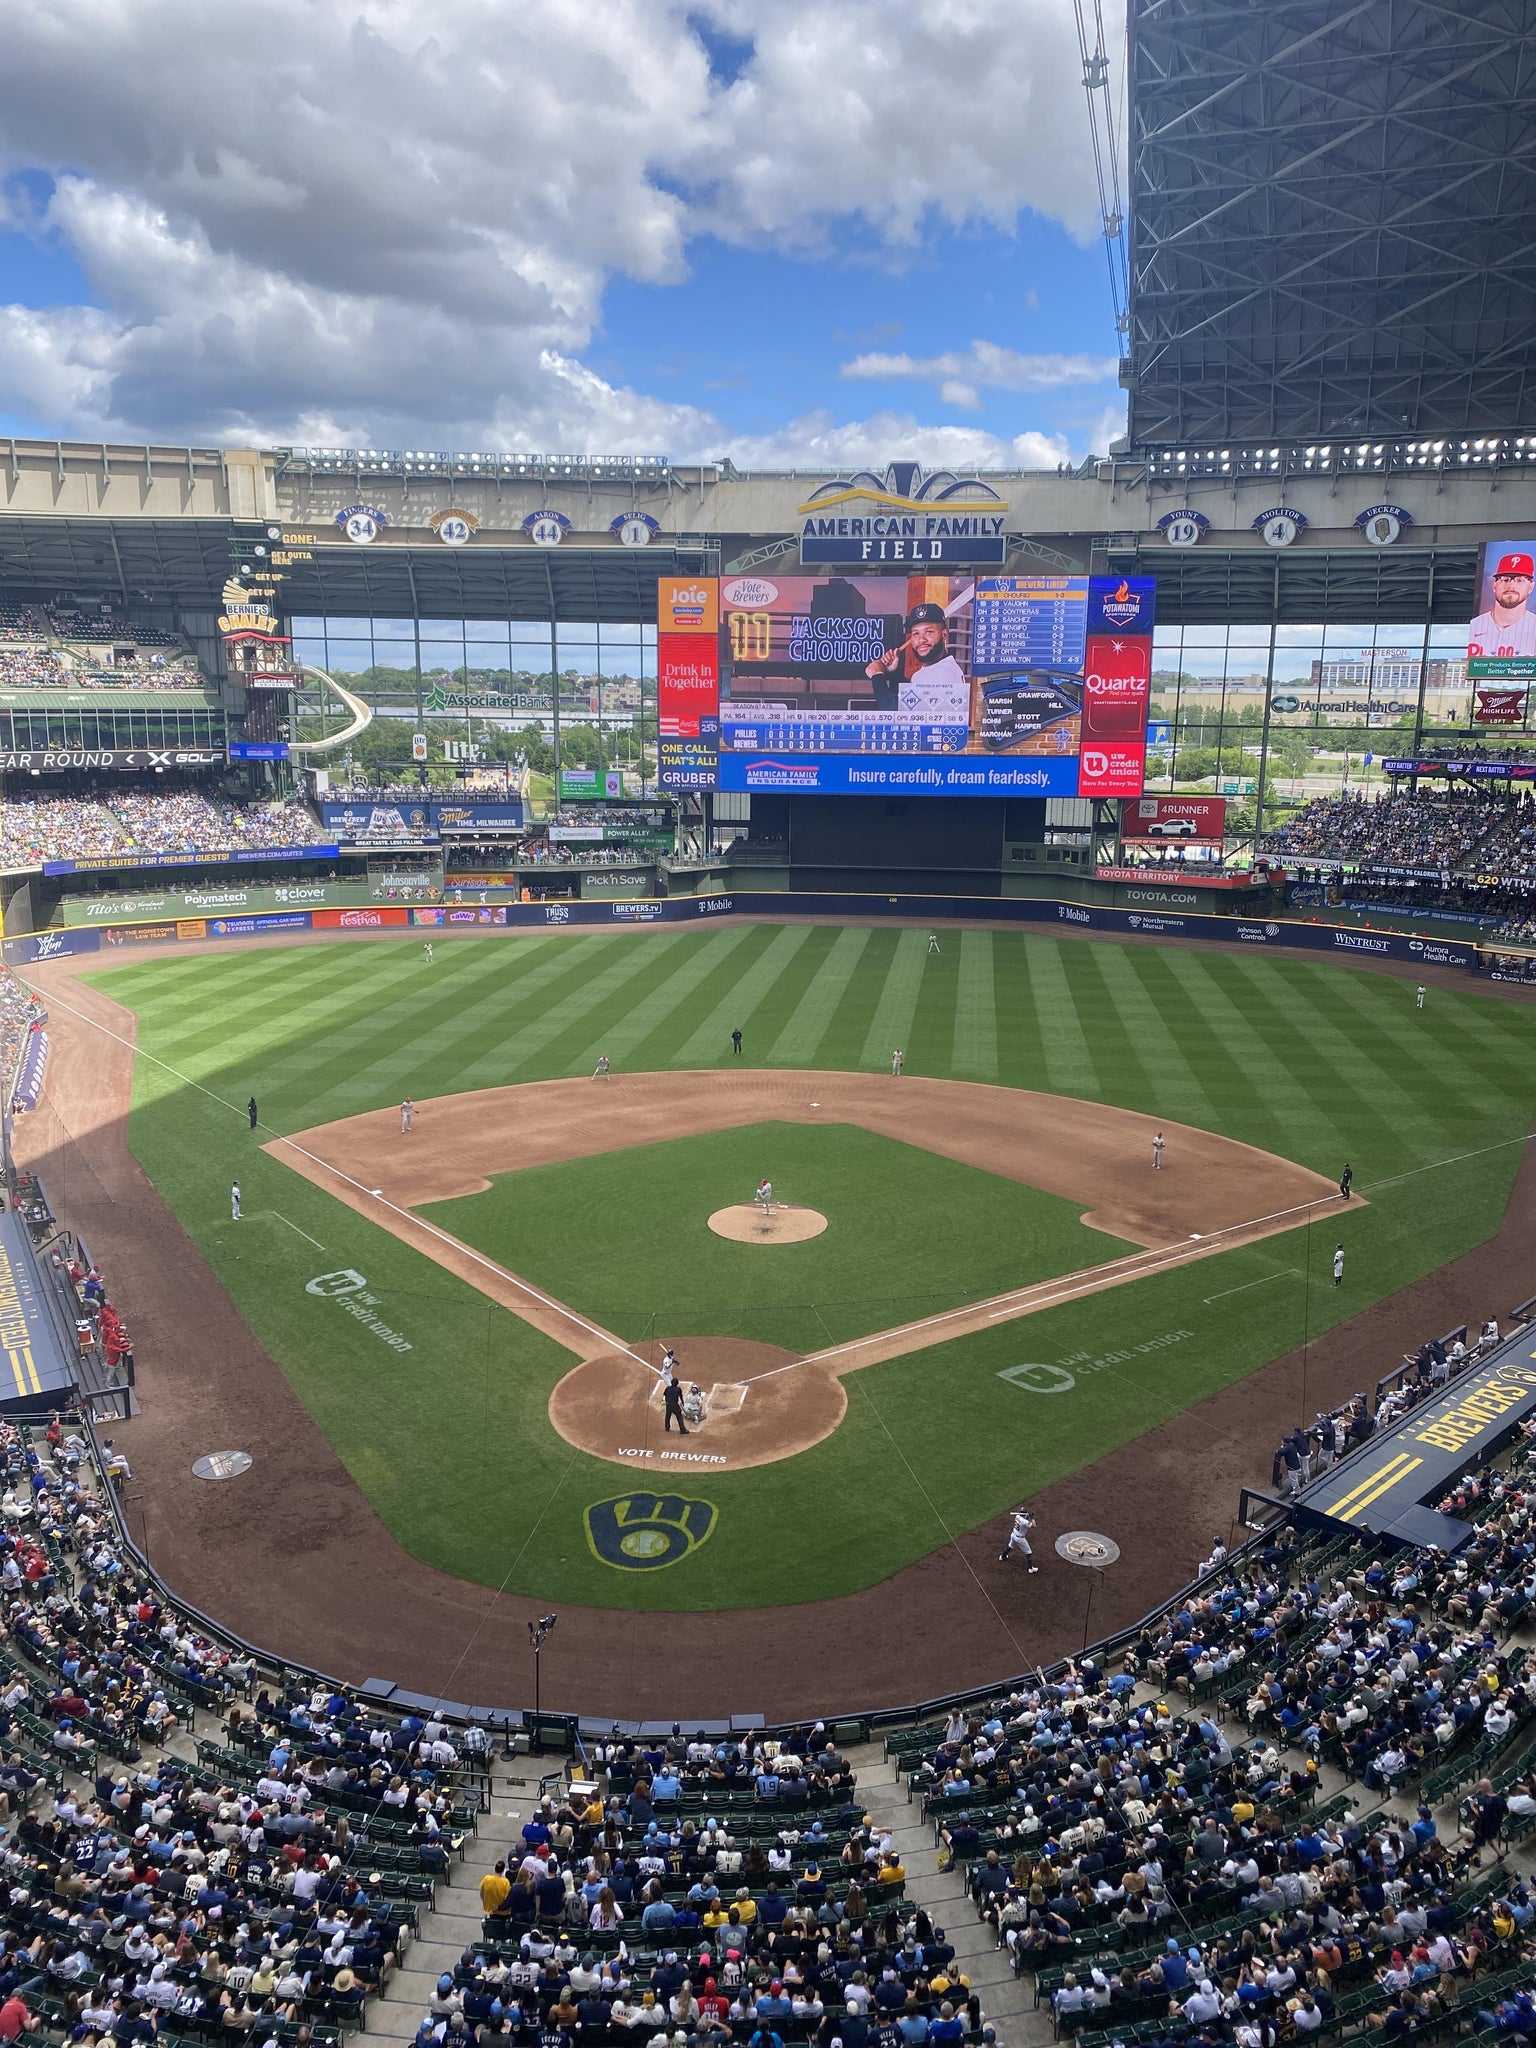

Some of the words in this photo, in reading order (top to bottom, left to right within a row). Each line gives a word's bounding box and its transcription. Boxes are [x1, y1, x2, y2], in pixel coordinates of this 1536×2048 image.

[343, 506, 378, 518] FINGERS
[534, 512, 560, 520] AARON
[624, 512, 646, 522] SELIG
[1170, 510, 1198, 520] YOUNT
[1261, 510, 1300, 522] MOLITOR
[1366, 506, 1400, 517] UECKER
[350, 520, 374, 536] 34
[444, 522, 466, 538] 42
[536, 523, 558, 538] 44
[803, 518, 916, 536] AMERICAN
[926, 517, 1005, 535] FAMILY
[1171, 524, 1194, 542] 19
[1271, 522, 1284, 540] 4
[282, 534, 316, 544] GONE!
[632, 526, 639, 543] 1
[862, 541, 942, 560] FIELD
[740, 581, 761, 592] Vote
[669, 585, 708, 605] Joie
[732, 592, 770, 603] Brewers
[228, 604, 268, 615] BERNIE'S
[1102, 604, 1140, 614] POTAWATOMI
[218, 615, 278, 633] CHALET
[790, 616, 884, 640] JACKSON
[730, 612, 770, 658] 11
[789, 640, 884, 662] CHOURIO
[1360, 648, 1407, 658] MASTERSON
[666, 664, 699, 676] Drink
[701, 664, 712, 676] in
[662, 676, 716, 690] Together
[1086, 674, 1146, 694] Quartz
[1303, 700, 1342, 712] Aurora
[1345, 700, 1385, 712] Health
[1387, 702, 1416, 713] Care
[1487, 696, 1514, 708] Miller
[444, 740, 481, 763] Lite
[662, 744, 683, 754] ONE
[685, 744, 717, 754] CALL...
[44, 753, 113, 766] ROUND
[148, 752, 170, 765] X
[176, 752, 224, 762] GOLF
[662, 756, 694, 766] THAT'S
[696, 756, 717, 766] ALL!
[1110, 760, 1139, 768] credit
[662, 772, 716, 784] GRUBER
[849, 769, 886, 784] Insure
[889, 769, 944, 786] carefully,
[947, 770, 985, 784] dream
[988, 770, 1050, 787] fearlessly.
[1110, 768, 1139, 776] union
[1161, 804, 1208, 815] 4RUNNER
[438, 810, 473, 826] Miller
[238, 850, 303, 859] BREWERS.COM/SUITES
[75, 859, 107, 869] PRIVATE
[108, 858, 138, 867] SUITES
[140, 857, 157, 866] FOR
[159, 856, 194, 864] PREMIER
[196, 854, 230, 862] GUESTS!
[1274, 856, 1339, 870] SHOREWEST.COM
[381, 874, 430, 886] Johnsonville
[451, 877, 487, 887] Surfside
[620, 875, 646, 884] Save
[1099, 869, 1131, 879] TOYOTA
[1132, 871, 1179, 882] TERRITORY
[1477, 874, 1498, 885] 620
[1501, 877, 1536, 888] WTMJ
[288, 887, 325, 899] clover
[1126, 890, 1196, 904] TOYOTA.COM
[1291, 886, 1322, 899] Culver's
[185, 893, 246, 906] Polymatech
[706, 899, 732, 911] Mobile
[86, 903, 120, 915] Tito's
[545, 908, 569, 918] TRUSS
[1066, 908, 1090, 922] Mobile
[340, 912, 381, 926] festival
[1143, 917, 1184, 926] Northwestern
[1142, 923, 1164, 931] Mutual
[1237, 926, 1262, 935] Johnson
[1240, 933, 1266, 941] Controls
[1335, 933, 1388, 950] WINTRUST
[1423, 944, 1449, 955] Aurora
[1423, 951, 1446, 962] Health
[1448, 955, 1466, 964] Care
[355, 1291, 382, 1306] uw
[335, 1296, 378, 1323] credit
[369, 1322, 412, 1353] union
[1076, 1349, 1136, 1374] credit
[1132, 1329, 1194, 1353] union
[1056, 1351, 1092, 1366] uw
[1396, 1414, 1434, 1440] HOME
[1441, 1396, 1458, 1407] OF
[1465, 1372, 1490, 1389] THE
[1415, 1380, 1528, 1453] BREWERS
[618, 1448, 654, 1458] VOTE
[660, 1451, 727, 1464] BREWERS
[762, 1781, 776, 1792] 19
[1137, 1813, 1146, 1824] 11
[76, 1846, 94, 1861] 22
[185, 1887, 198, 1900] 99
[233, 1976, 245, 1988] 10
[730, 1974, 739, 1984] 10
